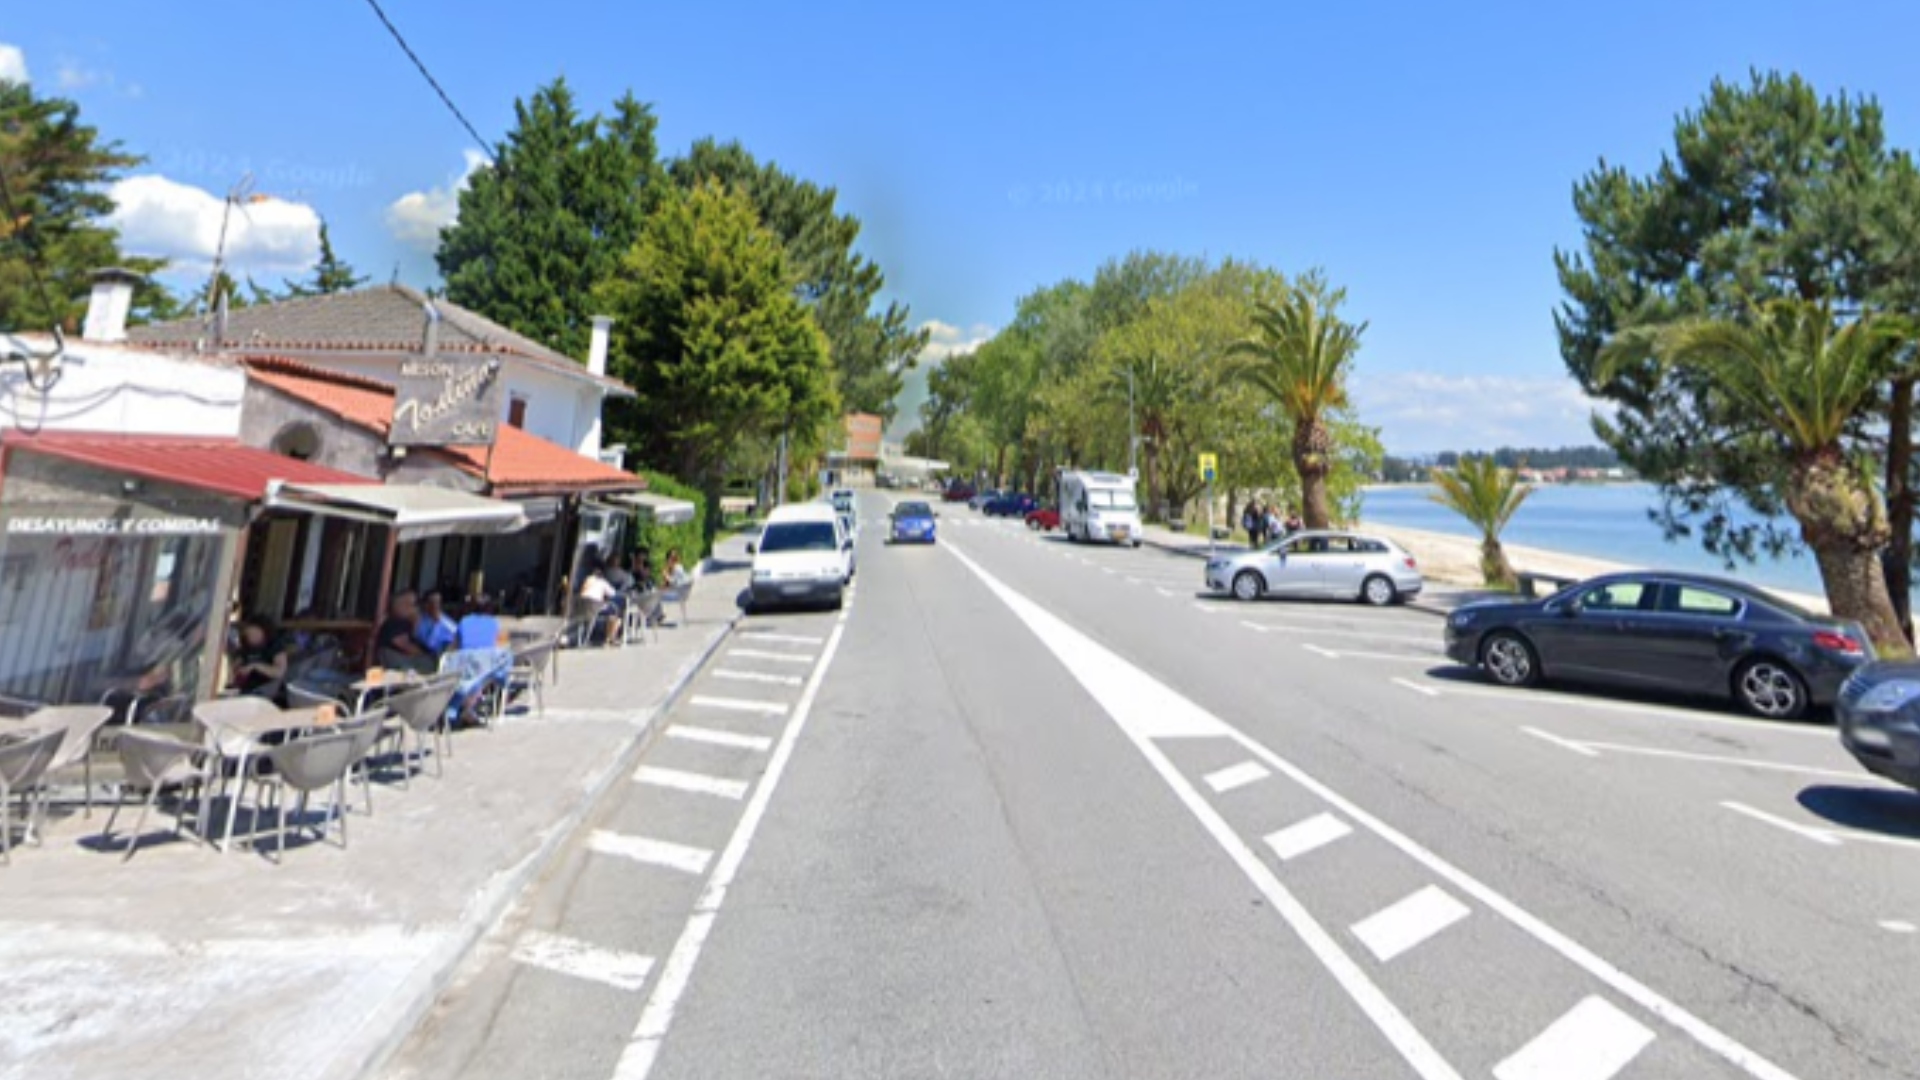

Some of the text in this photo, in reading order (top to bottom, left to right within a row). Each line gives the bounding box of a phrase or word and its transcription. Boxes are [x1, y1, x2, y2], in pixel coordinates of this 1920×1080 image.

[7, 517, 220, 533] DESAYUNOS Y COMIDAS
